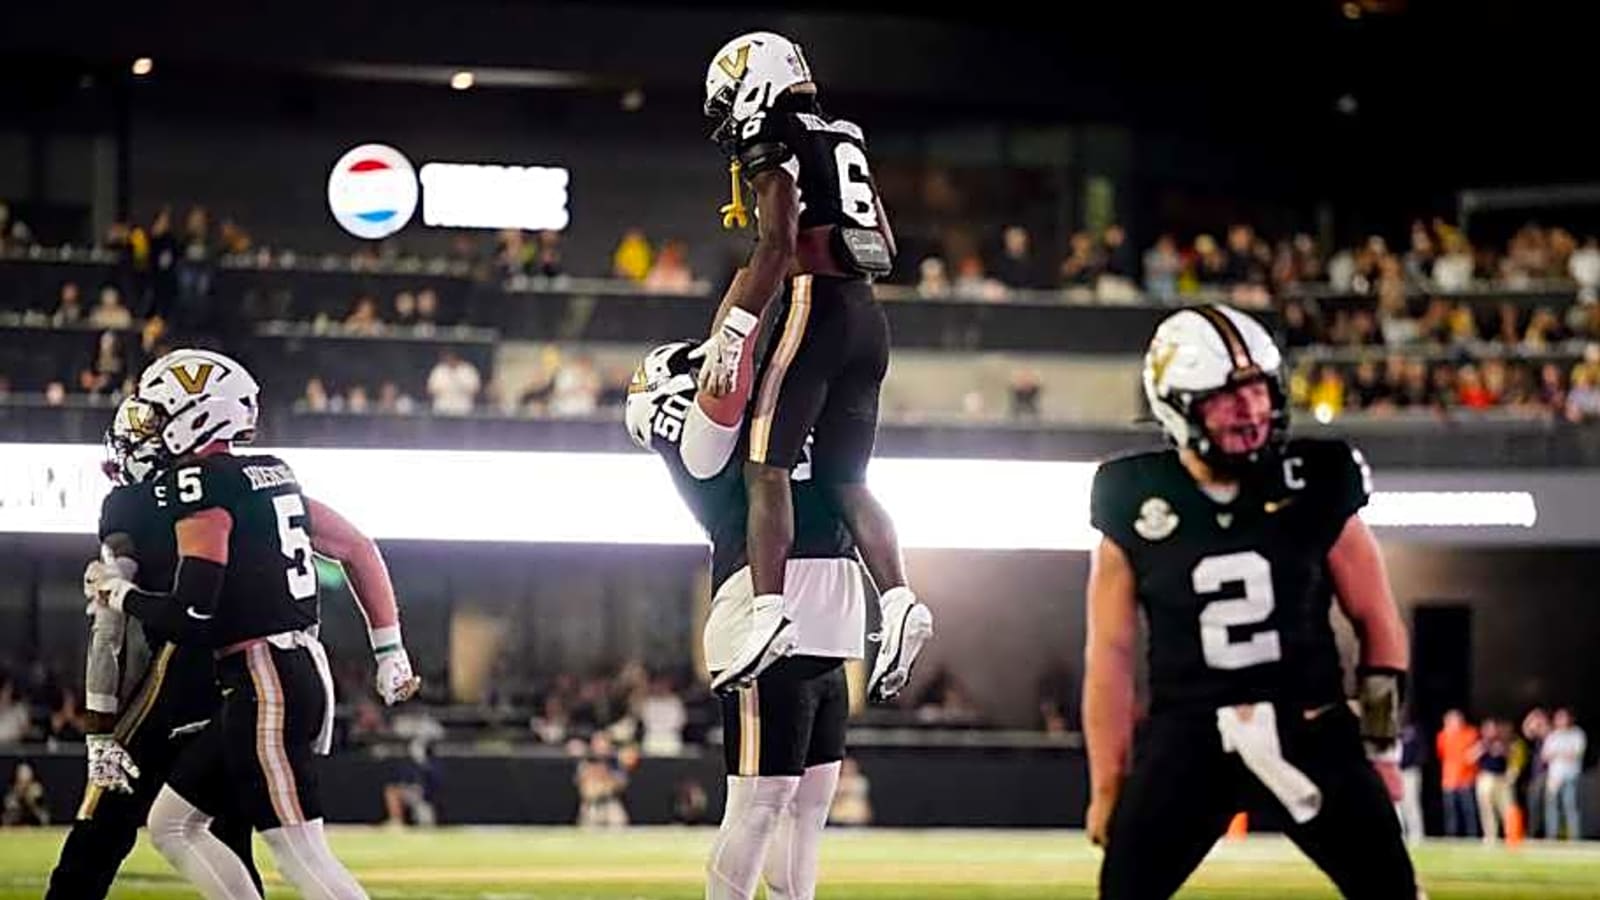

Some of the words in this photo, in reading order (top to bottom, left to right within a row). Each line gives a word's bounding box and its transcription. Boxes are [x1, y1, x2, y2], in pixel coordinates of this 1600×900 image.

[718, 44, 751, 80] V
[742, 111, 768, 140] 6
[834, 142, 879, 228] 6
[171, 364, 214, 394] V
[653, 394, 693, 442] 50
[177, 466, 203, 503] 5
[1283, 457, 1306, 490] C
[272, 493, 317, 600] 5
[1192, 551, 1281, 670] 2
